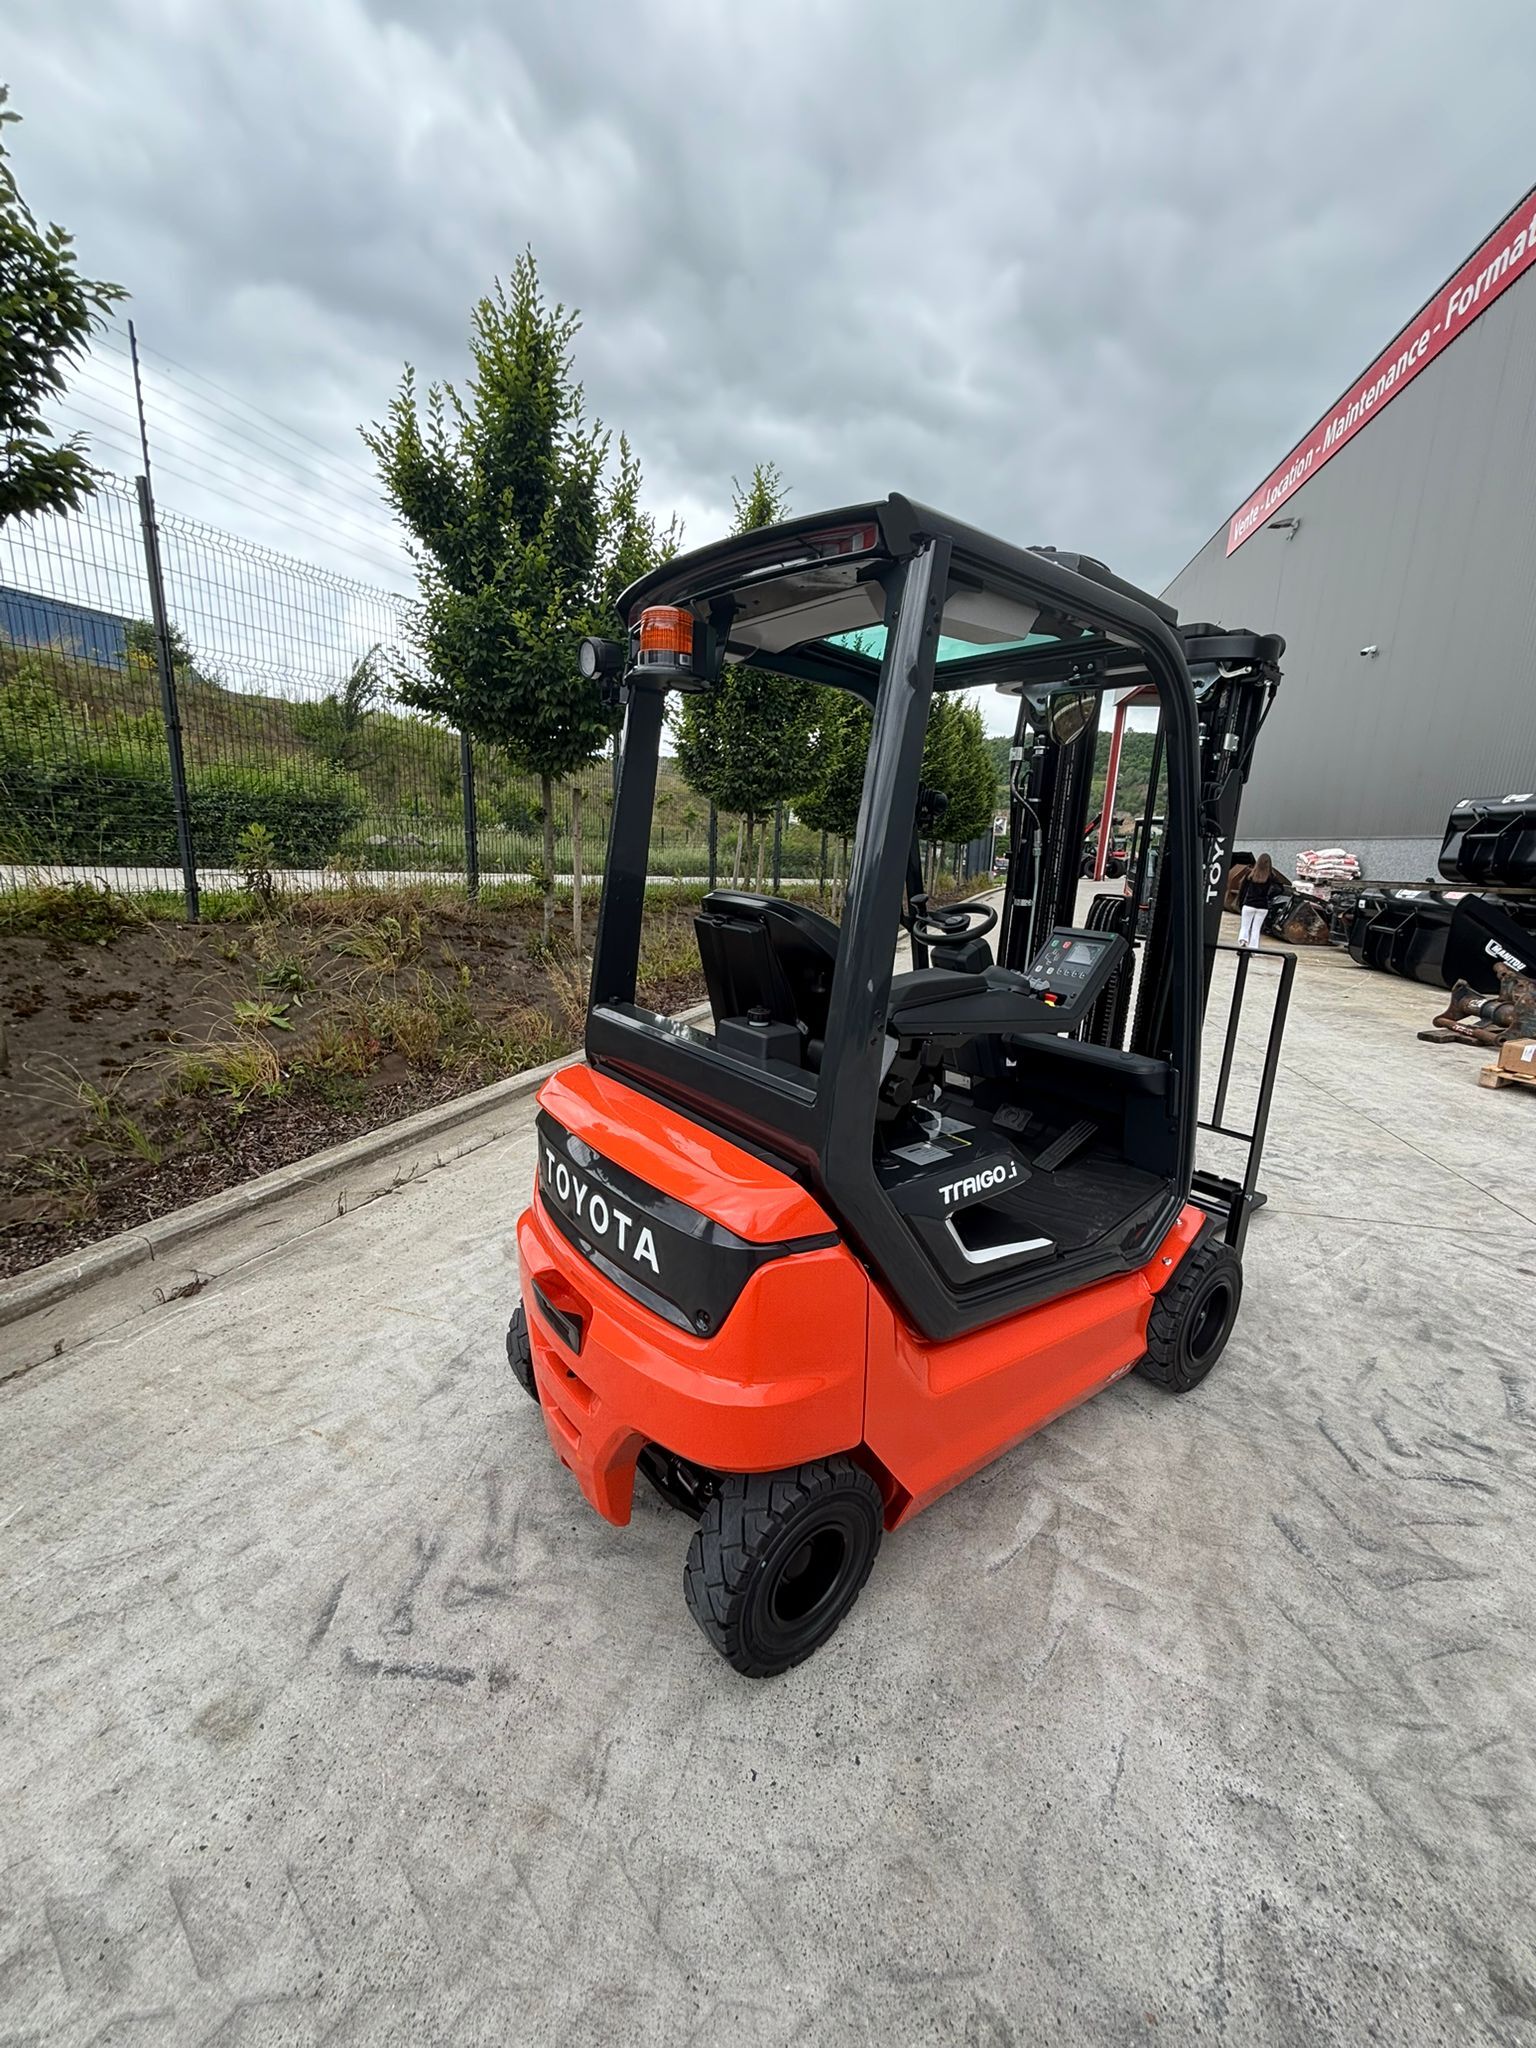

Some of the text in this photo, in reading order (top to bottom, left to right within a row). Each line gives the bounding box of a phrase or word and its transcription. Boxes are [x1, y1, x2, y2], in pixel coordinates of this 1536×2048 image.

[1233, 505, 1259, 541] Vente
[1264, 448, 1314, 511] Location
[1322, 328, 1431, 454] Maintenance
[1205, 836, 1226, 903] TOY
[545, 1148, 660, 1275] TOYOTA
